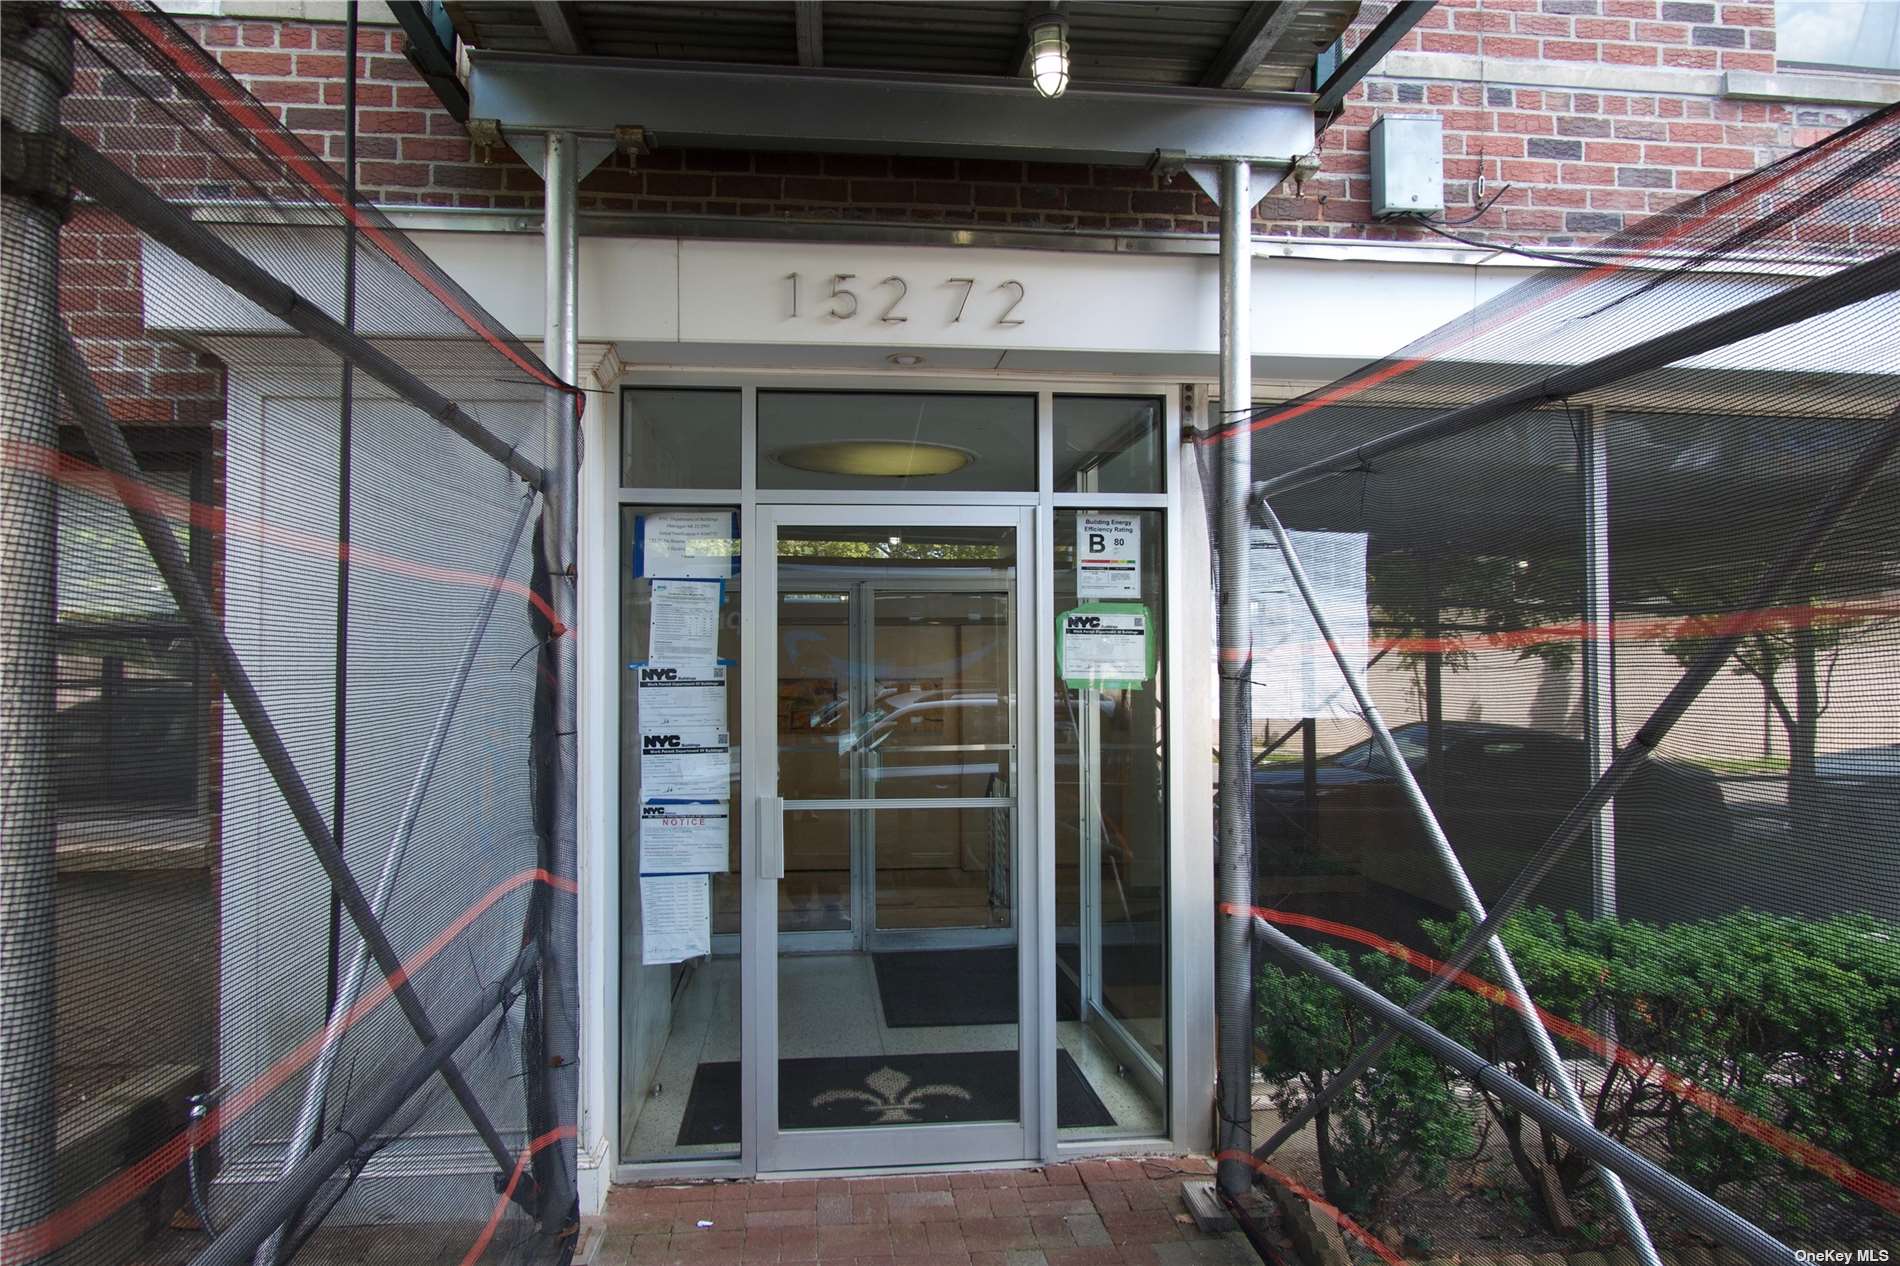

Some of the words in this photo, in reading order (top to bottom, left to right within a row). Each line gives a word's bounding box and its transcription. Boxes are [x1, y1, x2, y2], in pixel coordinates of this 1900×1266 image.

[1089, 533, 1106, 553] B
[1113, 538, 1125, 546] 80
[1068, 616, 1100, 628] NYC
[642, 668, 677, 680] NYC
[644, 735, 680, 748] NYC
[662, 818, 705, 826] NOTICE
